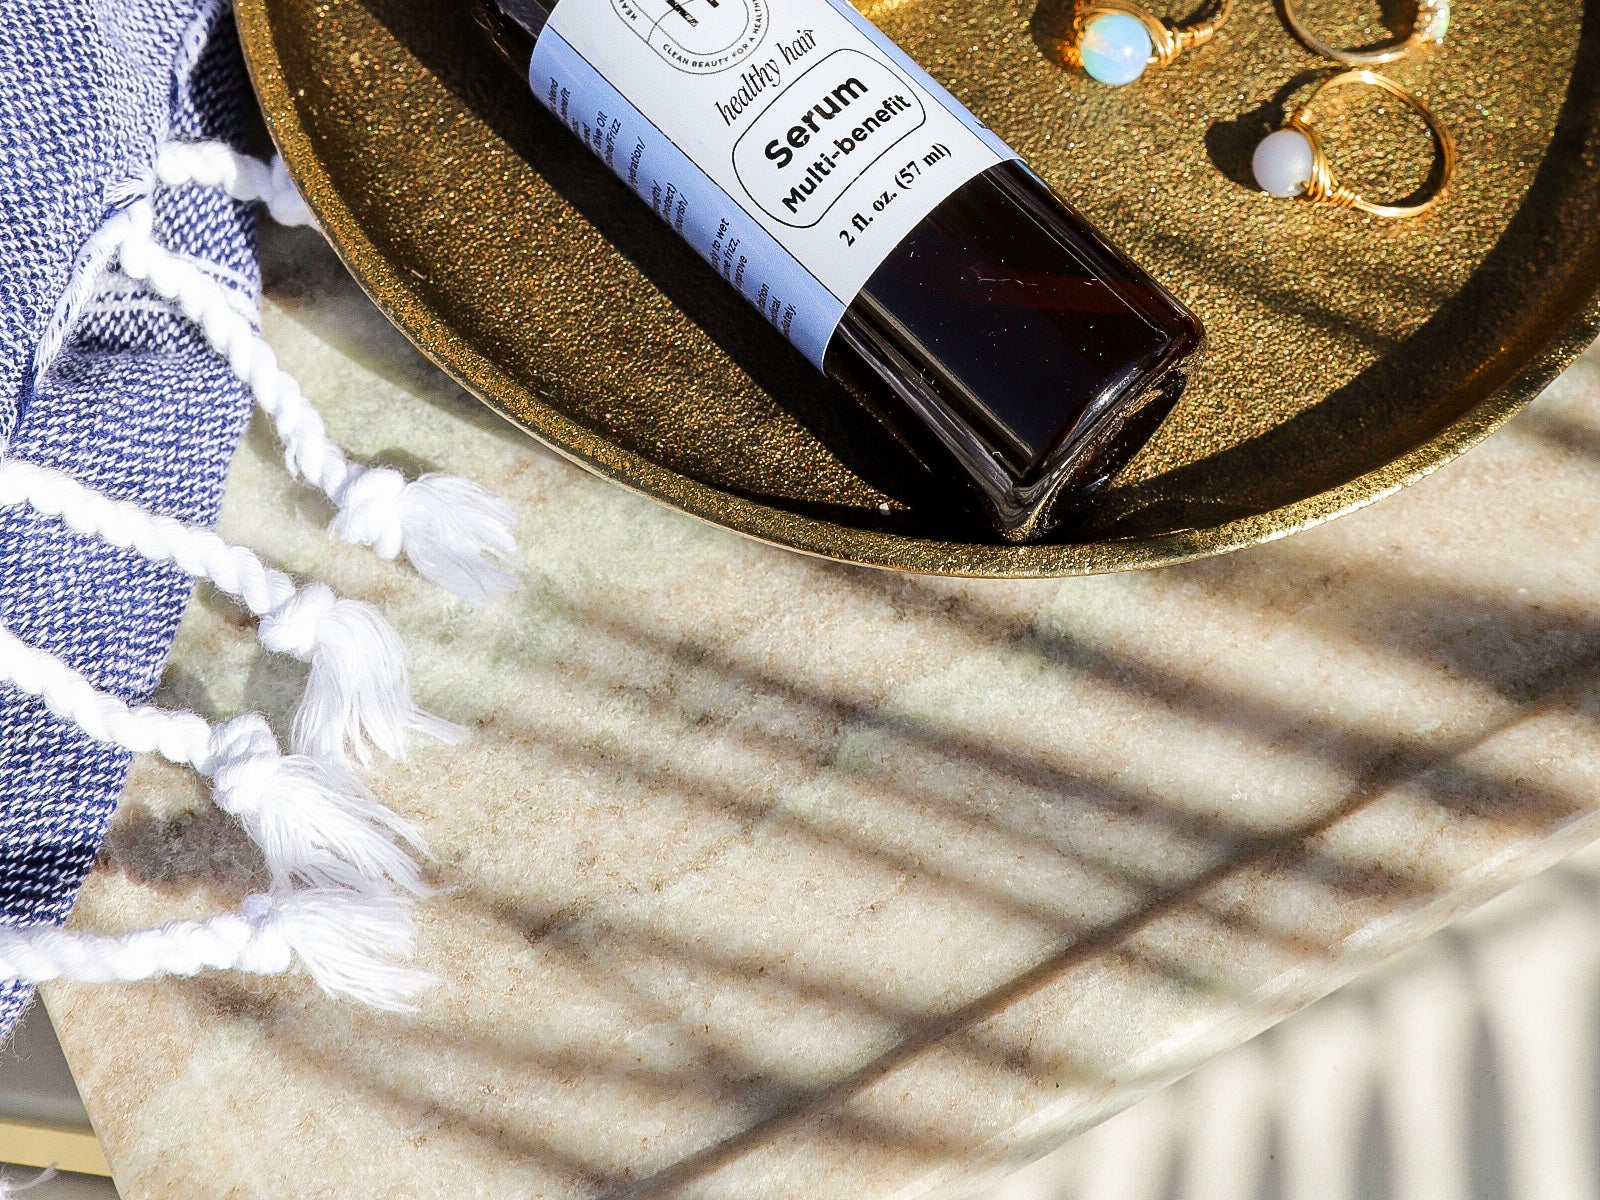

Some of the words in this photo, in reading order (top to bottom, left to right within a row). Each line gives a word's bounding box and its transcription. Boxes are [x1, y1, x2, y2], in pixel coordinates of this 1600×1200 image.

[662, 43, 689, 66] CLEAN
[692, 56, 729, 69] BEAUTY
[731, 43, 749, 58] FOR
[713, 58, 781, 127] healthy
[775, 29, 818, 65] hair
[597, 110, 608, 129] Oil
[764, 77, 869, 170] Serum
[781, 94, 911, 214] Multi-benefit
[839, 229, 856, 247] 2
[851, 212, 874, 233] fl.
[872, 190, 898, 212] oz.
[894, 160, 922, 190] (57
[922, 142, 952, 167] ml)
[715, 217, 730, 240] wet
[712, 239, 721, 252] to
[723, 237, 741, 260] frizz,
